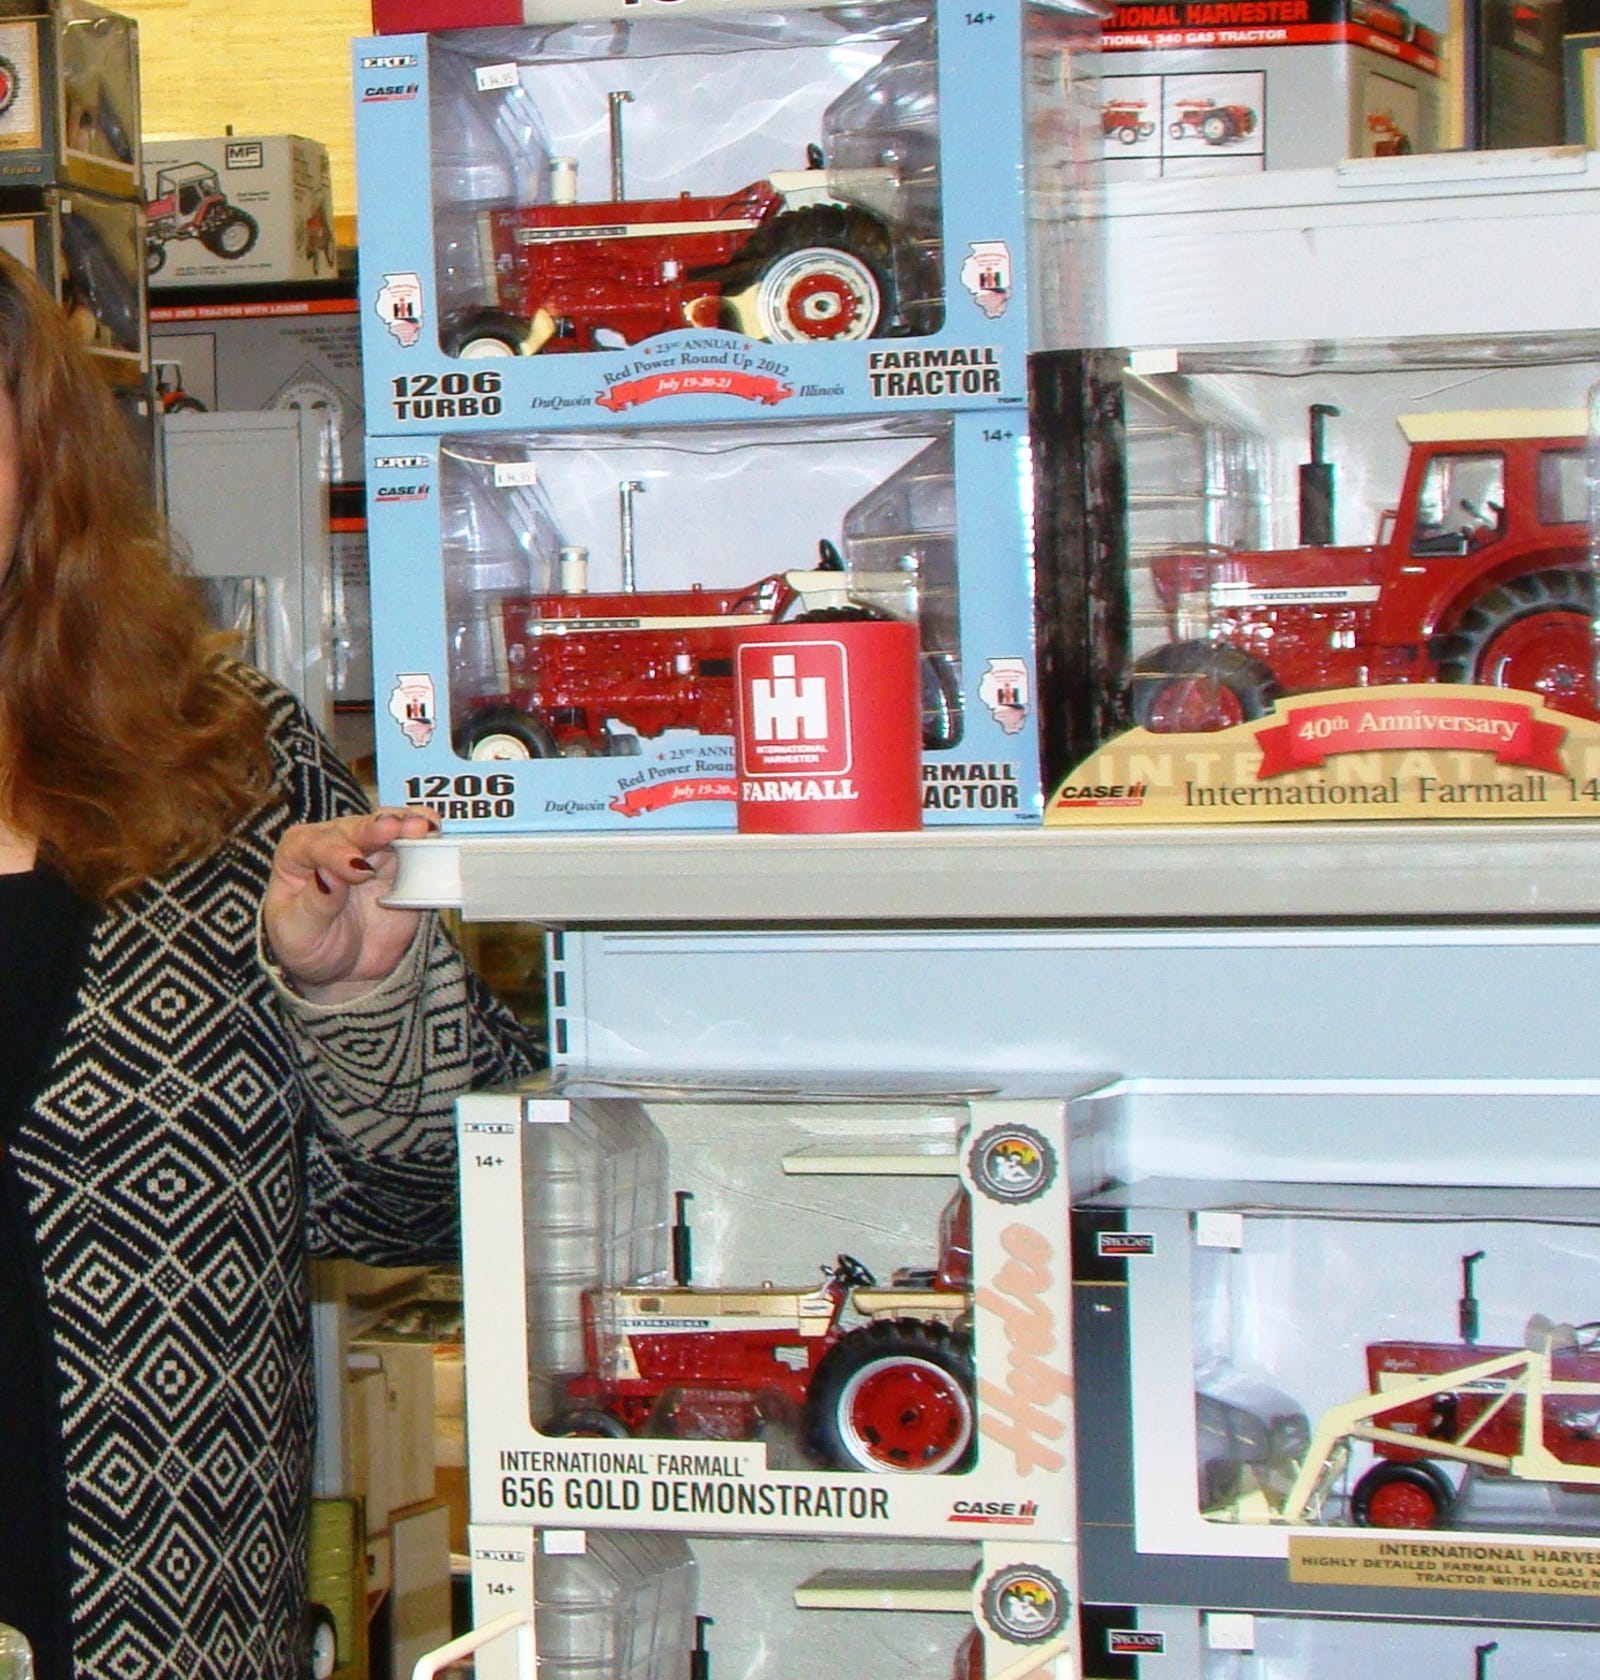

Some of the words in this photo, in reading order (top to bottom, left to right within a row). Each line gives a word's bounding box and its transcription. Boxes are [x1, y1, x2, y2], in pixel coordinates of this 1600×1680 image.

[965, 13, 996, 25] 14+
[1187, 1, 1309, 24] HARVESTER
[1187, 31, 1215, 43] GAS
[1218, 29, 1287, 41] TRACTOR
[361, 55, 417, 69] ERTL
[365, 85, 404, 97] CASE
[229, 146, 259, 158] MF
[683, 338, 741, 352] ANNUAL
[869, 348, 998, 370] FARMALL
[603, 365, 632, 387] Red
[633, 356, 676, 376] Power
[680, 352, 728, 366] Round
[733, 353, 752, 371] Up
[756, 357, 790, 378] 2012
[391, 371, 502, 398] 1206
[656, 376, 681, 393] July
[683, 375, 733, 390] 19-20-21
[870, 367, 1002, 398] TRACTOR
[531, 395, 592, 410] DuQuoin
[799, 383, 846, 398] Illinois
[392, 395, 502, 420] TURBO
[982, 428, 1014, 441] 14+
[374, 456, 429, 469] ERTL
[377, 486, 416, 497] CASE
[1298, 714, 1350, 741] 40th
[1358, 707, 1520, 742] Anniversary
[763, 754, 820, 764] HARVESTER
[617, 769, 646, 791] Red
[648, 761, 692, 780] Power
[695, 759, 736, 774] Roun
[923, 762, 1017, 782] RMALL
[405, 773, 515, 799] 1206
[672, 784, 696, 800] July
[741, 779, 860, 802] FARMALL
[1061, 785, 1123, 801] CASE
[1184, 778, 1400, 808] International
[1418, 775, 1547, 806] Farmall
[544, 798, 606, 814] DuQuoin
[923, 784, 1021, 810] ACTOR
[475, 1155, 505, 1168] 14+
[500, 1449, 648, 1476] INTERNATIONAL
[656, 1453, 744, 1478] FARMALL
[501, 1476, 554, 1508] 656
[565, 1478, 639, 1511] GOLD
[652, 1481, 890, 1520] DEMONSTRATOR
[953, 1500, 1015, 1516] CASE
[1379, 1543, 1526, 1562] INTERNATIONAL
[1301, 1555, 1358, 1569] HIGHLY
[1363, 1559, 1437, 1571] DETAILED
[1442, 1561, 1513, 1575] FARMALL
[1554, 1566, 1584, 1577] GAS
[486, 1582, 515, 1596] 14+
[1416, 1572, 1486, 1585] TRACTOR
[1492, 1576, 1532, 1587] WITH
[1538, 1577, 1600, 1590] LOADER
